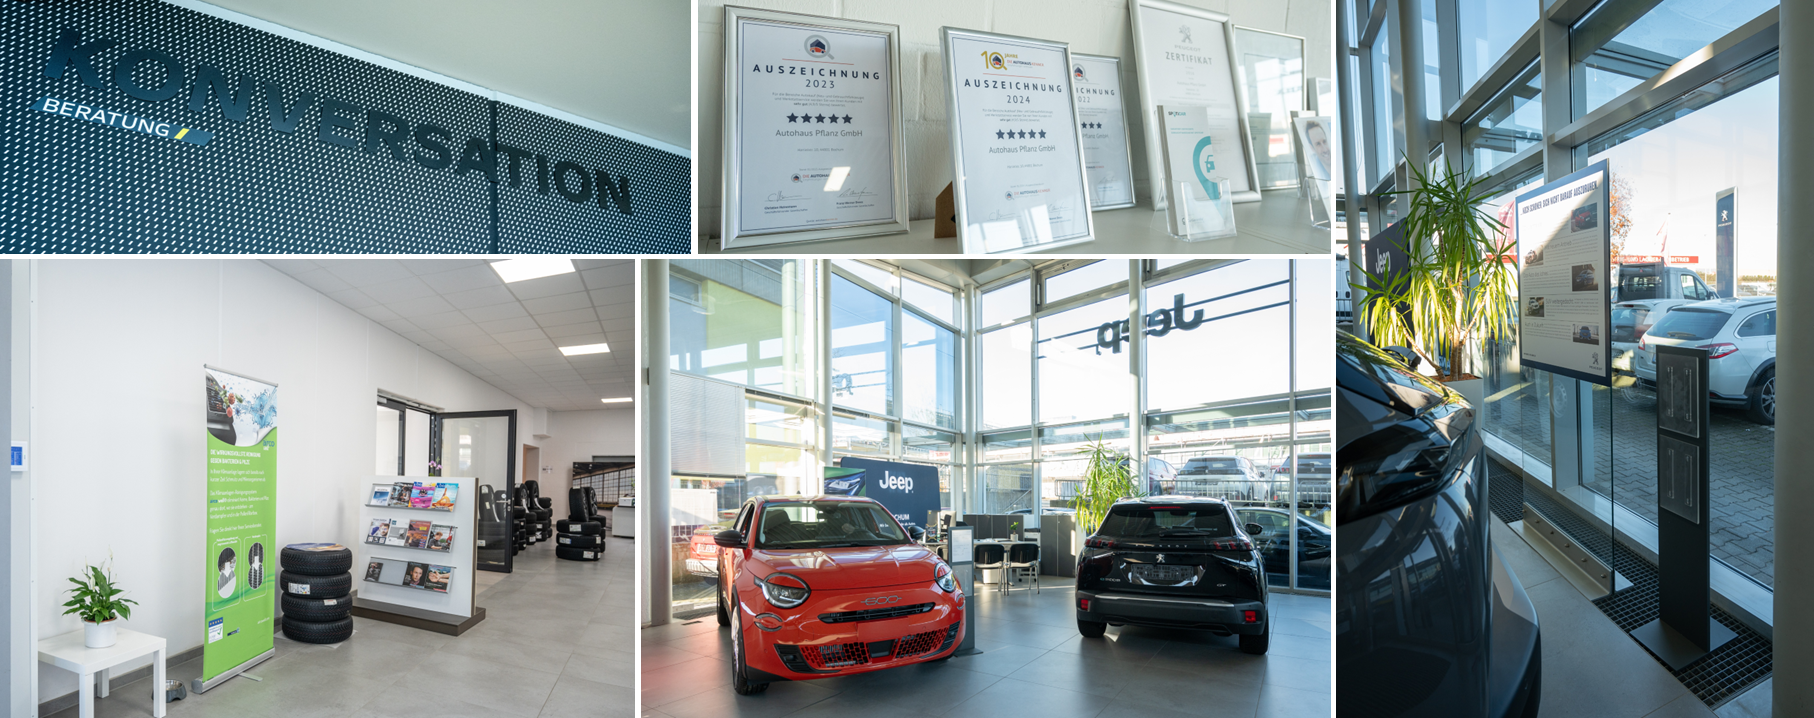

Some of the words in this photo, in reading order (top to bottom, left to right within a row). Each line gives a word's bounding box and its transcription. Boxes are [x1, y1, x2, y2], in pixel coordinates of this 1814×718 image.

[1165, 51, 1212, 65] ZERTIFIKAT
[753, 64, 880, 80] AUSZEICHNUNG
[805, 79, 835, 88] 2023
[964, 78, 1062, 92] AUSZEICHNUNG
[1076, 87, 1115, 96] ICHNUNG
[1007, 95, 1030, 104] 2024
[42, 98, 171, 137] BERATUNG
[43, 28, 633, 214] KONVERSATION
[1560, 189, 1573, 202] DARAUF
[879, 470, 914, 493] Jeep
[861, 595, 902, 606] 600
